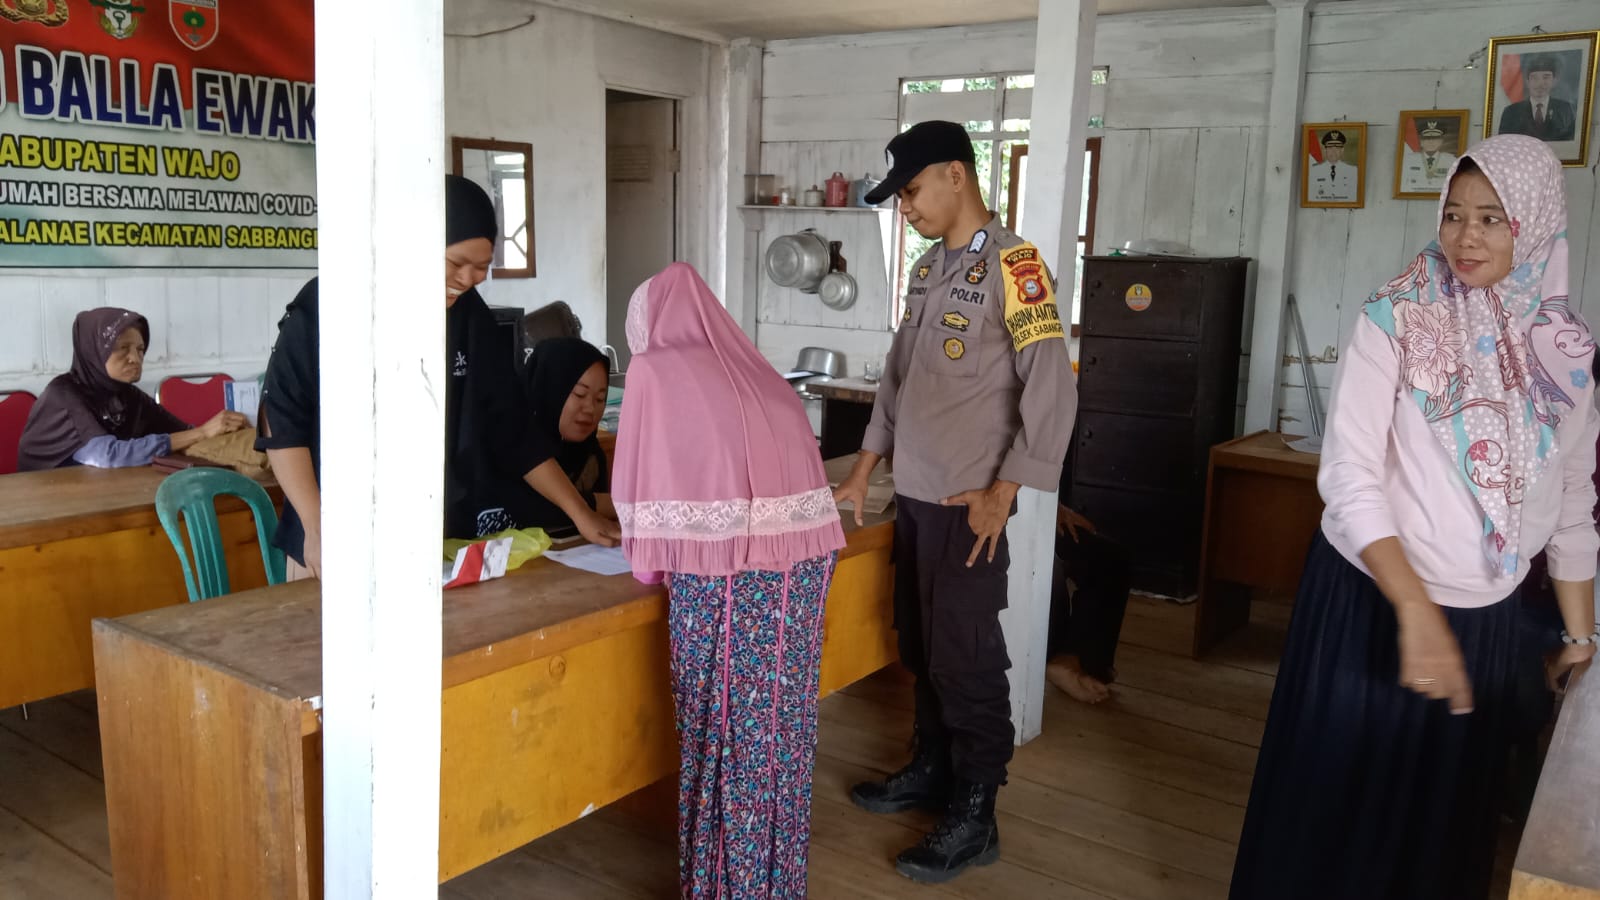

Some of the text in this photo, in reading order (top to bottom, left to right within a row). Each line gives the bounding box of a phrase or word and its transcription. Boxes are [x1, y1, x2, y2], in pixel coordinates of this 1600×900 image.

[17, 46, 184, 131] BALLA
[0, 134, 240, 180] ABUPATEN WAJO
[63, 183, 164, 209] BERSAMA
[168, 189, 258, 214] MELAWAN
[94, 222, 222, 248] KECAMATAN
[950, 287, 985, 305] POLRI
